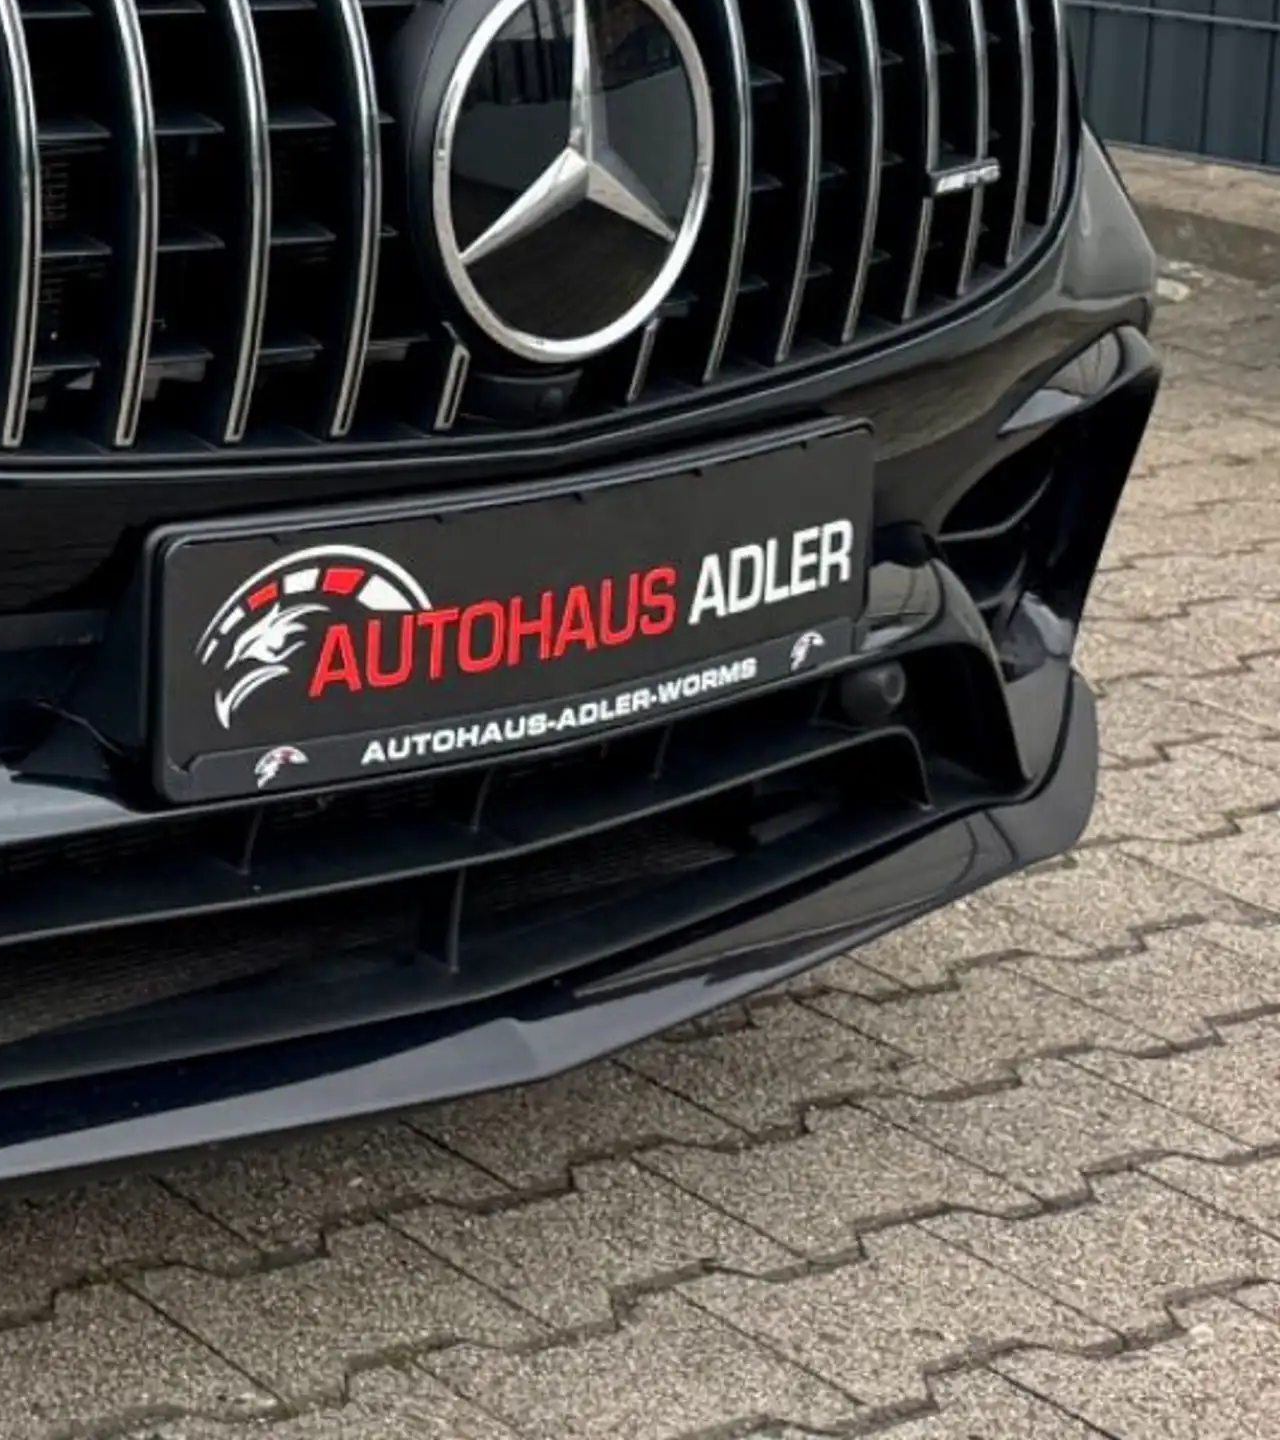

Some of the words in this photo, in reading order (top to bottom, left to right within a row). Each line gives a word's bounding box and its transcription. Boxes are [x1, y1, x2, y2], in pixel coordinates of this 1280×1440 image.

[308, 566, 678, 698] AUTOHAUS
[687, 518, 855, 626] ADLER
[359, 656, 759, 766] AUTOHAUS-ADLER-WORMS
